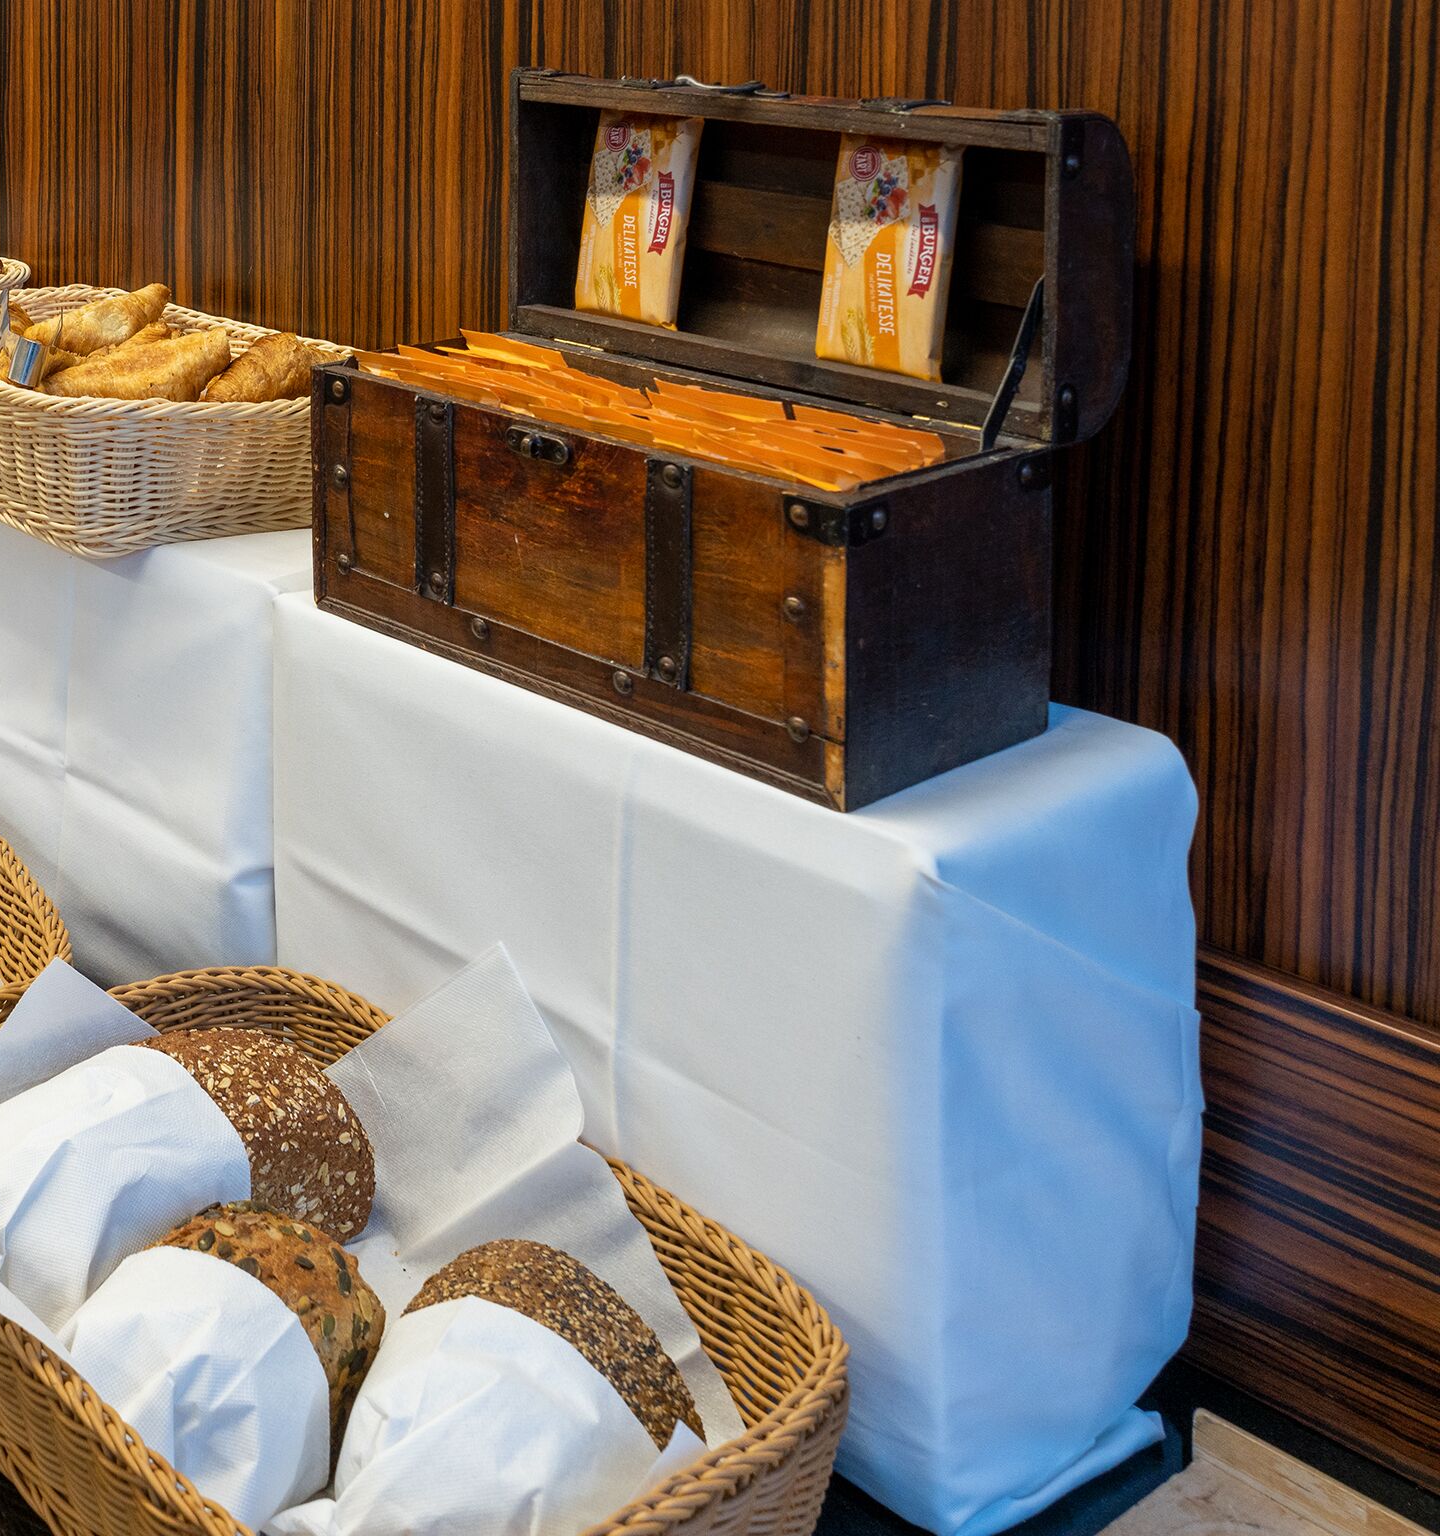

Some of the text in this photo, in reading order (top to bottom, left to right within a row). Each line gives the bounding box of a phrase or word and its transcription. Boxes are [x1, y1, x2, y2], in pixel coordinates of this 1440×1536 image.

[856, 153, 867, 173] ZART
[653, 188, 671, 243] BURGER
[623, 214, 637, 288] DELIKATESSE
[914, 224, 935, 285] BURGER
[876, 252, 895, 336] DELIKATESSE
